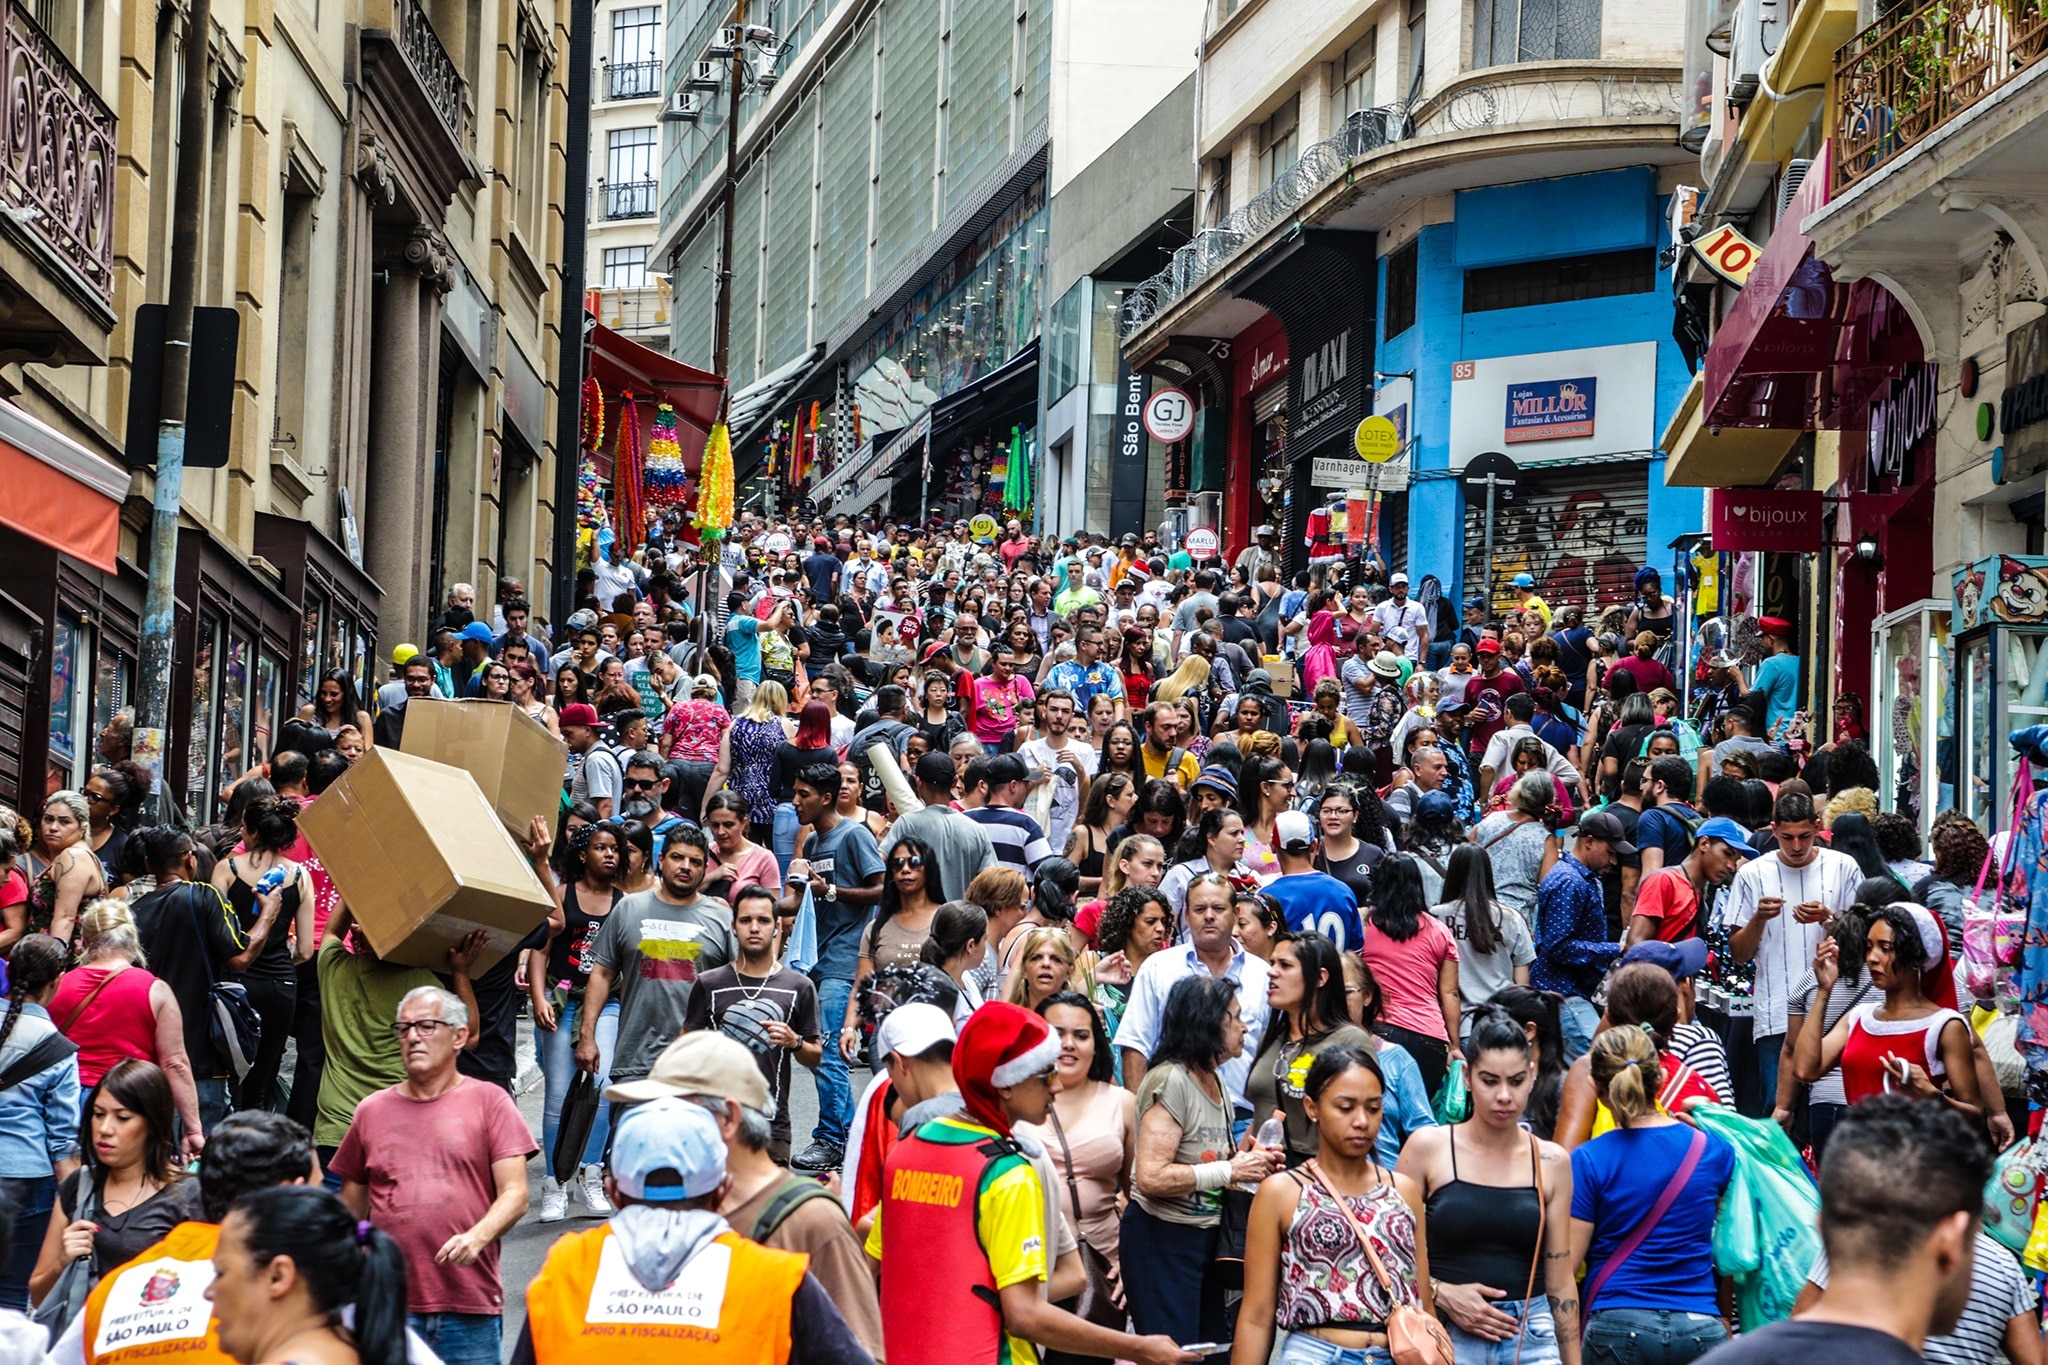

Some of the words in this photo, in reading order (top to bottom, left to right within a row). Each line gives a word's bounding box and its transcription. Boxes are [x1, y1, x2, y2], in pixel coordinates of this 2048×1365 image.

[1705, 229, 1759, 276] 10
[1207, 339, 1232, 359] 73
[1298, 331, 1348, 407] MAXI
[1455, 364, 1472, 379] 85
[1125, 370, 1142, 416] Bent
[1513, 390, 1533, 399] Lojas
[1153, 398, 1185, 422] GJ
[1512, 394, 1587, 417] MILLOR
[1512, 417, 1543, 426] Fantasias
[1544, 415, 1551, 423] &
[1553, 412, 1587, 423] Acessórios
[1886, 362, 1938, 487] bijoux
[1122, 424, 1140, 456] São
[1358, 430, 1395, 441] LOTEX
[1314, 459, 1367, 475] Varnhagen
[977, 521, 989, 529] GJ
[1724, 505, 1729, 521] I
[1750, 506, 1808, 527] bijoux
[1188, 537, 1215, 545] MARLU
[902, 626, 917, 635] OFF
[904, 618, 918, 629] 30%
[866, 768, 883, 799] Yes
[1300, 911, 1346, 953] 10
[1445, 915, 1470, 941] BEA
[891, 1168, 964, 1208] BOMBEIRO
[687, 1292, 703, 1301] DE
[108, 1309, 174, 1328] PREFEITURA
[178, 1306, 192, 1316] DE
[605, 1302, 638, 1315] SÃO
[642, 1303, 702, 1317] PAULO
[105, 1327, 132, 1346] SÃO
[135, 1319, 189, 1337] PAULO
[581, 1326, 616, 1336] APOIO
[620, 1328, 626, 1336] A
[631, 1328, 720, 1343] FISCALIZAÇÃO
[124, 1340, 208, 1359] FISCALIZAÇÃO
